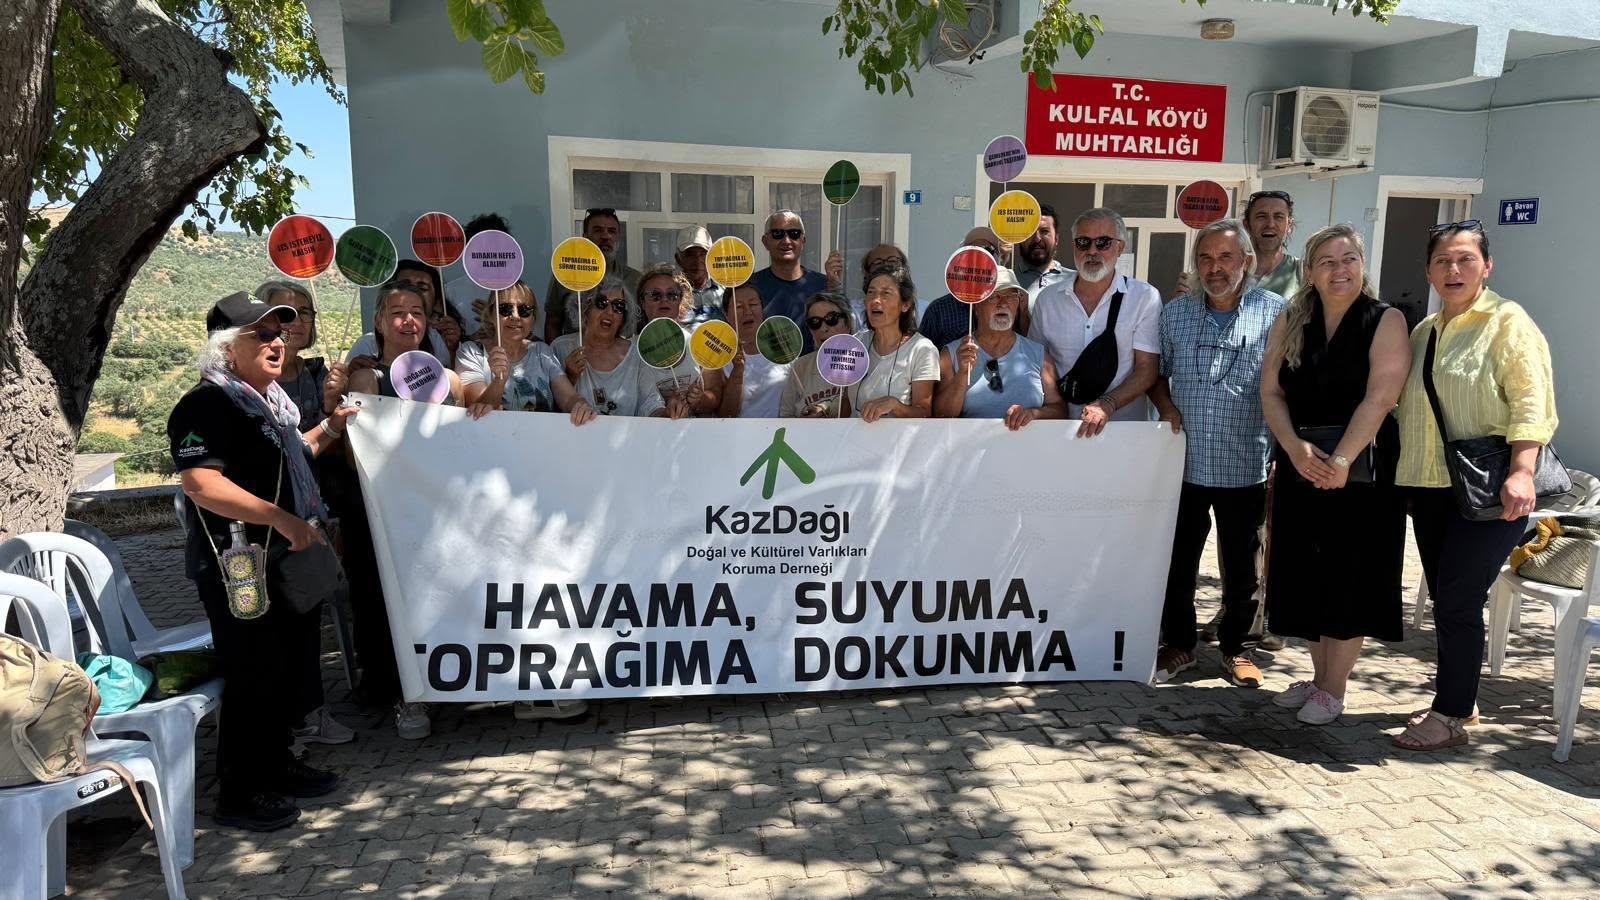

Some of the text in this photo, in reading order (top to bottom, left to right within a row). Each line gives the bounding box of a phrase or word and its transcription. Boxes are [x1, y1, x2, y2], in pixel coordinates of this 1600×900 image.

[1112, 83, 1150, 101] T.C.
[1049, 104, 1208, 129] KULFAL KÖYÜ
[1055, 132, 1199, 155] MUHTARLIĞI
[909, 193, 916, 202] 9
[1517, 212, 1530, 221] WC
[848, 350, 865, 358] SEVEN
[705, 504, 849, 542] KazDağı
[687, 546, 726, 561] Doğal
[751, 546, 804, 558] Kültürel
[808, 545, 867, 557] Varlıkları
[722, 562, 833, 576] Koruma Derneği
[484, 578, 1048, 631] HAVAMA, SUYUMA,
[414, 630, 757, 692] OPRAĞIMA
[794, 630, 1076, 682] DOKUNMA
